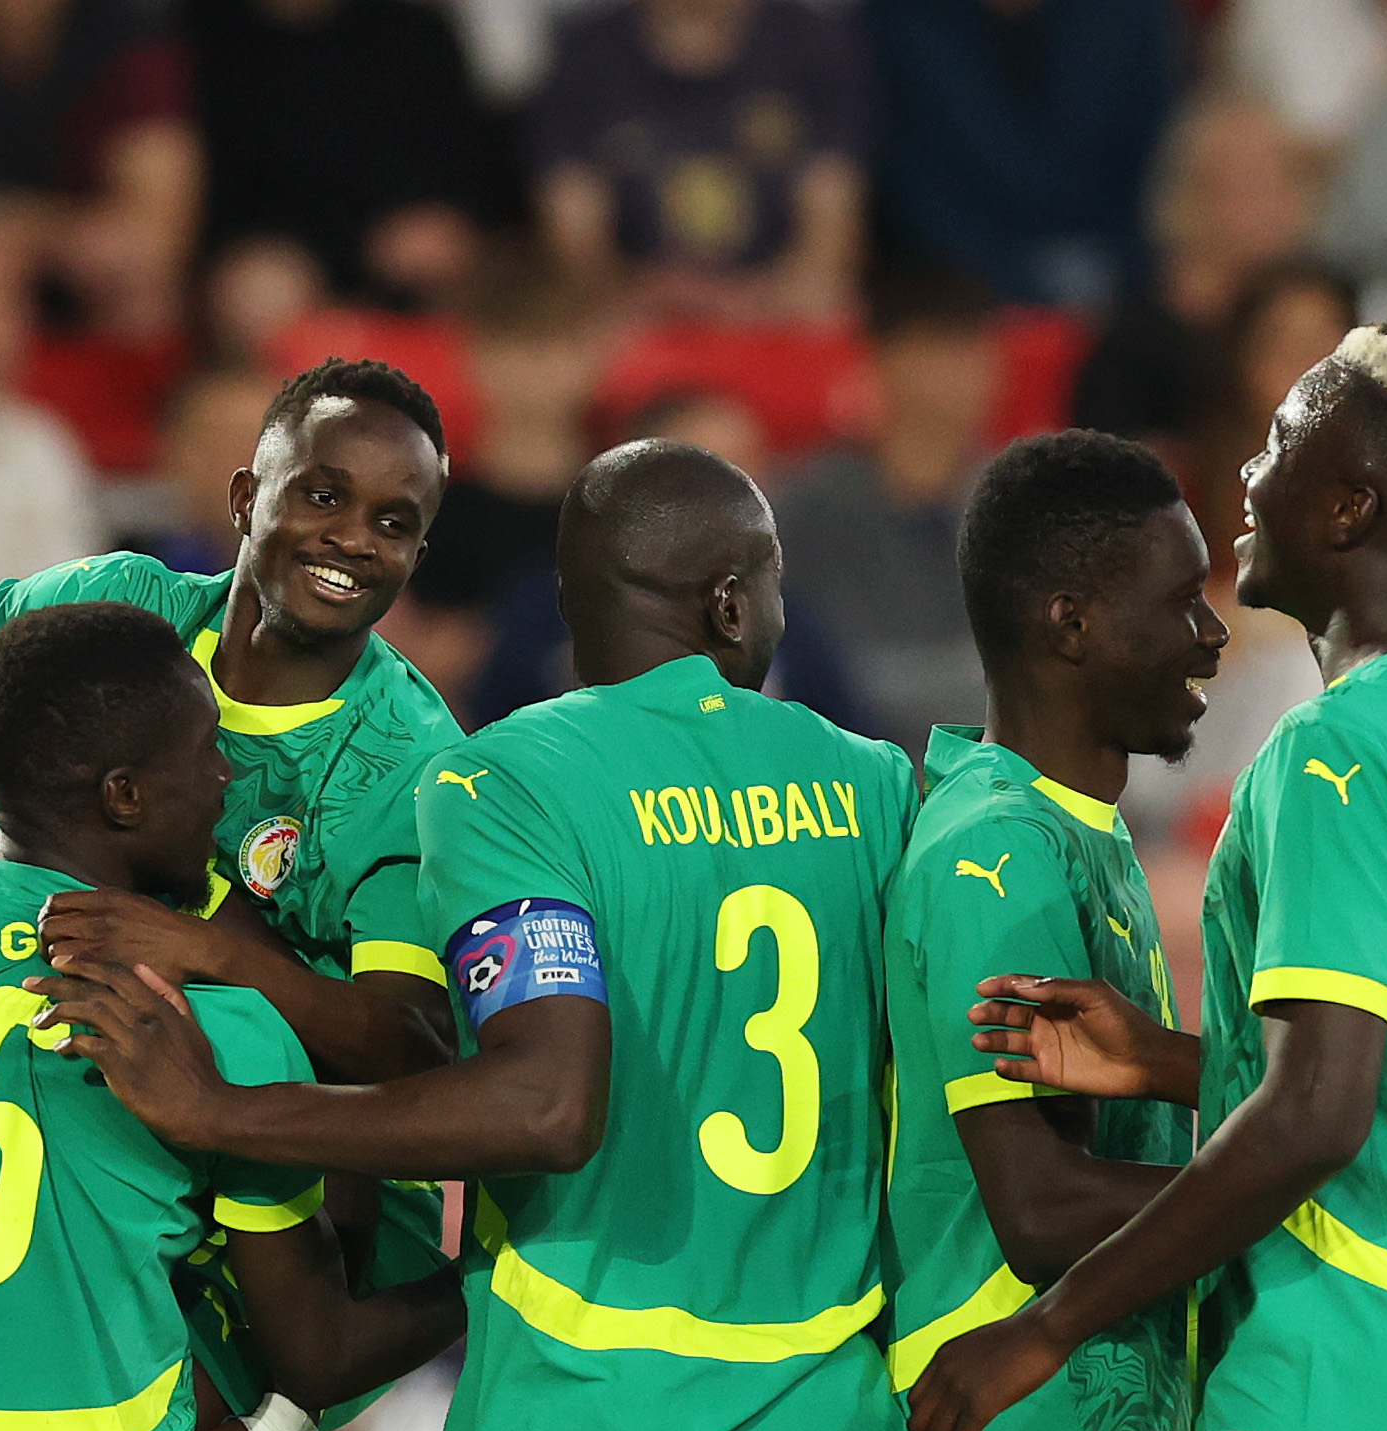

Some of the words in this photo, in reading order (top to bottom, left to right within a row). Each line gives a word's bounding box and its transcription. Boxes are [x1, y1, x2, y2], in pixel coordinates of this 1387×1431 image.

[521, 917, 591, 938] FOOTBALL
[525, 931, 596, 955] UNITES
[530, 949, 560, 965] the
[560, 949, 600, 972] World
[540, 970, 575, 981] FIFA
[698, 884, 820, 1196] 3
